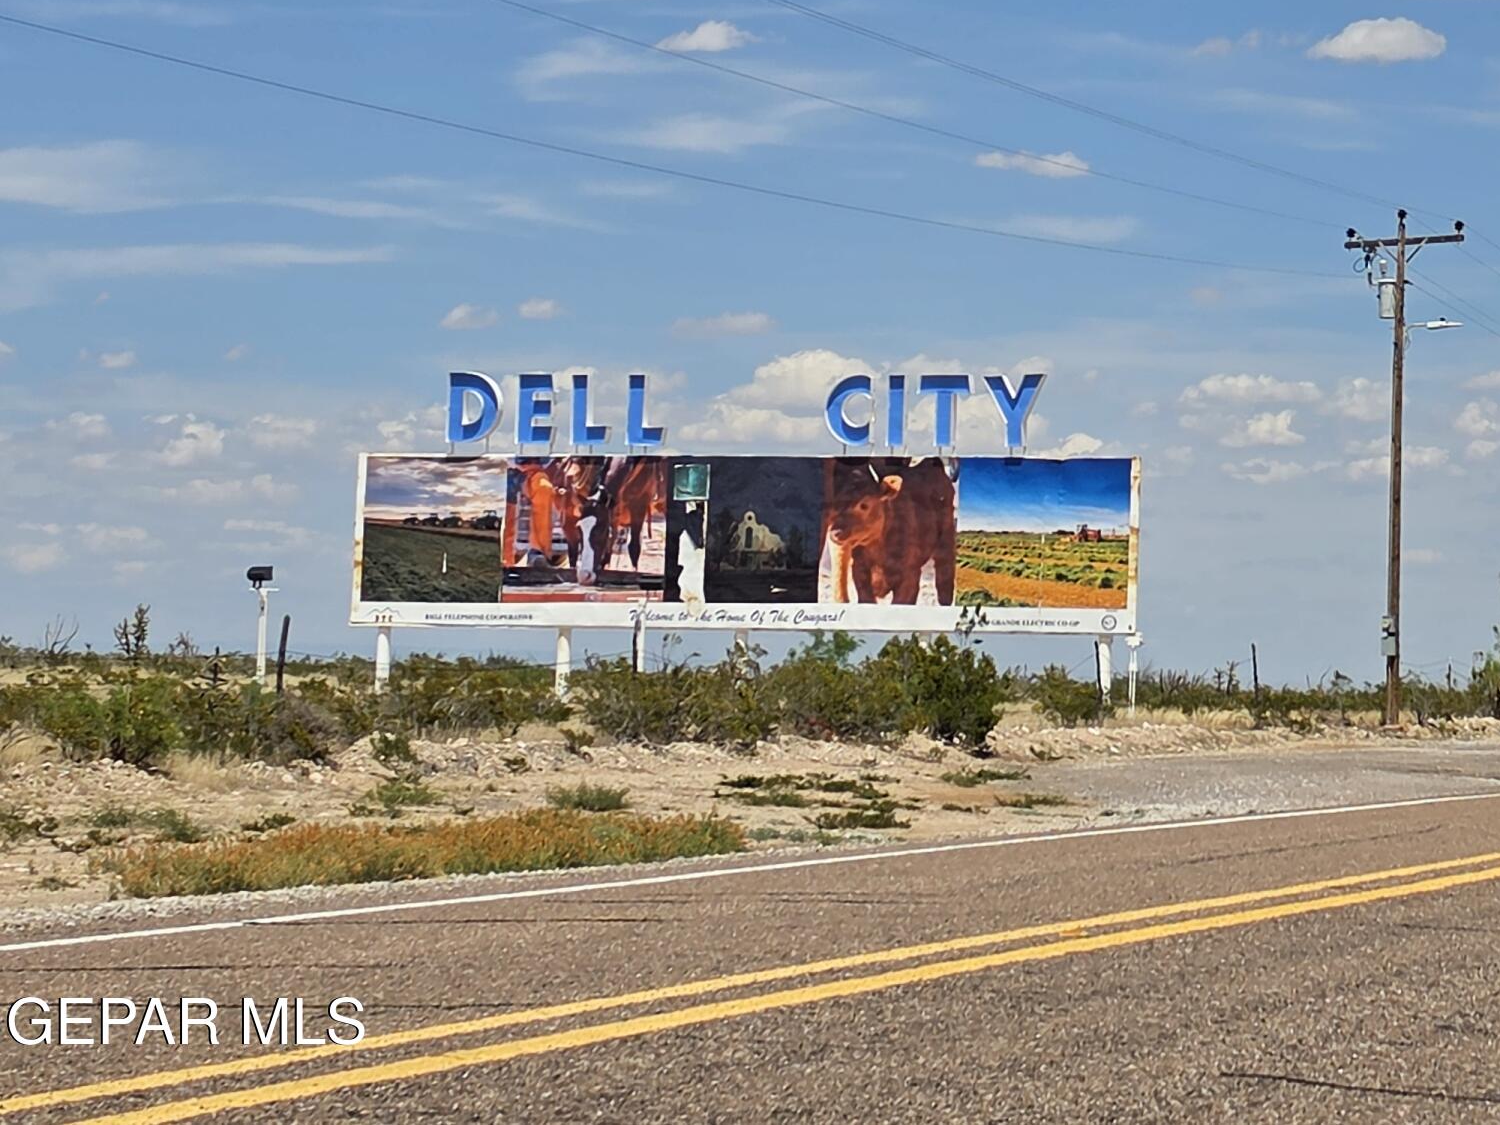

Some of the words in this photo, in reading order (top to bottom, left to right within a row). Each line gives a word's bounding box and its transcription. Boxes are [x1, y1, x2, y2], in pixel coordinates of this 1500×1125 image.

[445, 371, 668, 445] DELL
[824, 374, 1048, 447] CITY
[678, 611, 688, 621] to
[715, 609, 745, 622] Home
[750, 610, 765, 625] Of
[769, 610, 789, 623] The
[793, 609, 846, 625] Cougars!
